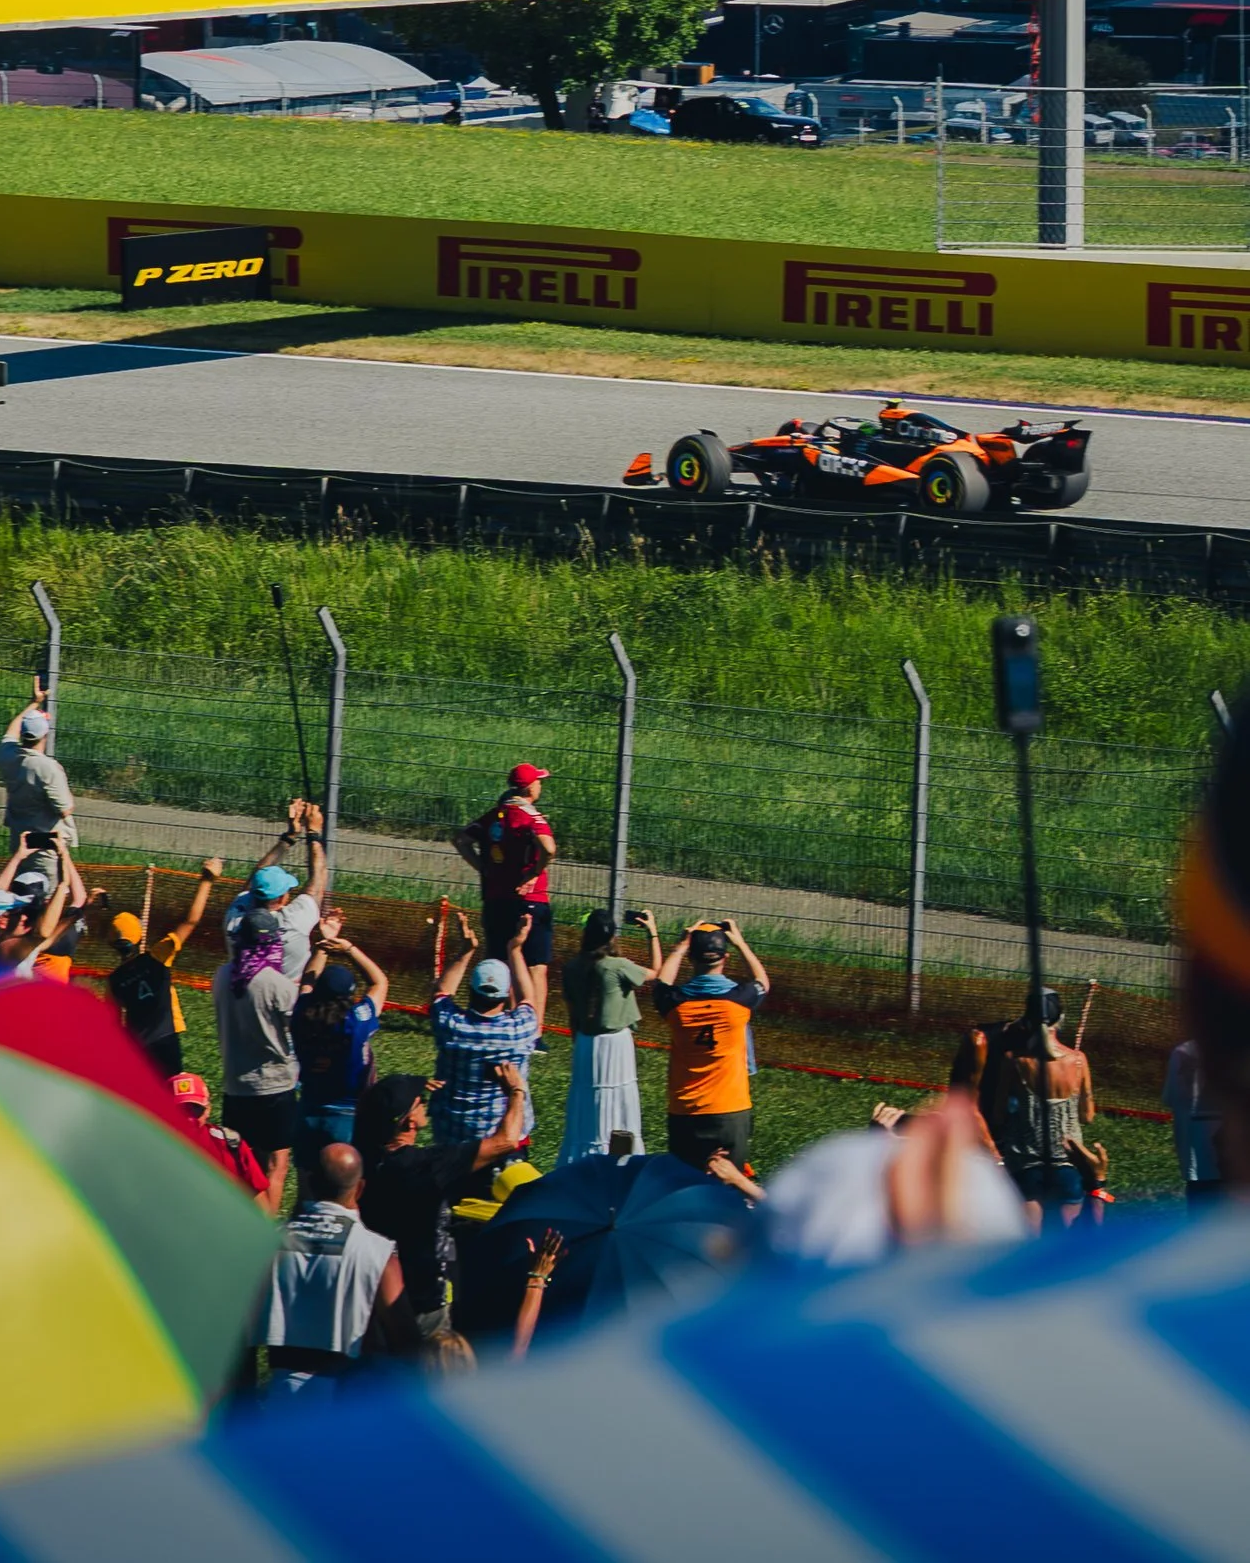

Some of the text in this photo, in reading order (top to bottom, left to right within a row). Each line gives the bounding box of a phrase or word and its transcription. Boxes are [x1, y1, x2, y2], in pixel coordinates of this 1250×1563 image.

[133, 257, 264, 287] P ZERO
[437, 235, 642, 310] PIRELLI
[782, 260, 998, 336] PIRELLI
[1147, 282, 1250, 352] PIR
[695, 1024, 719, 1050] 4
